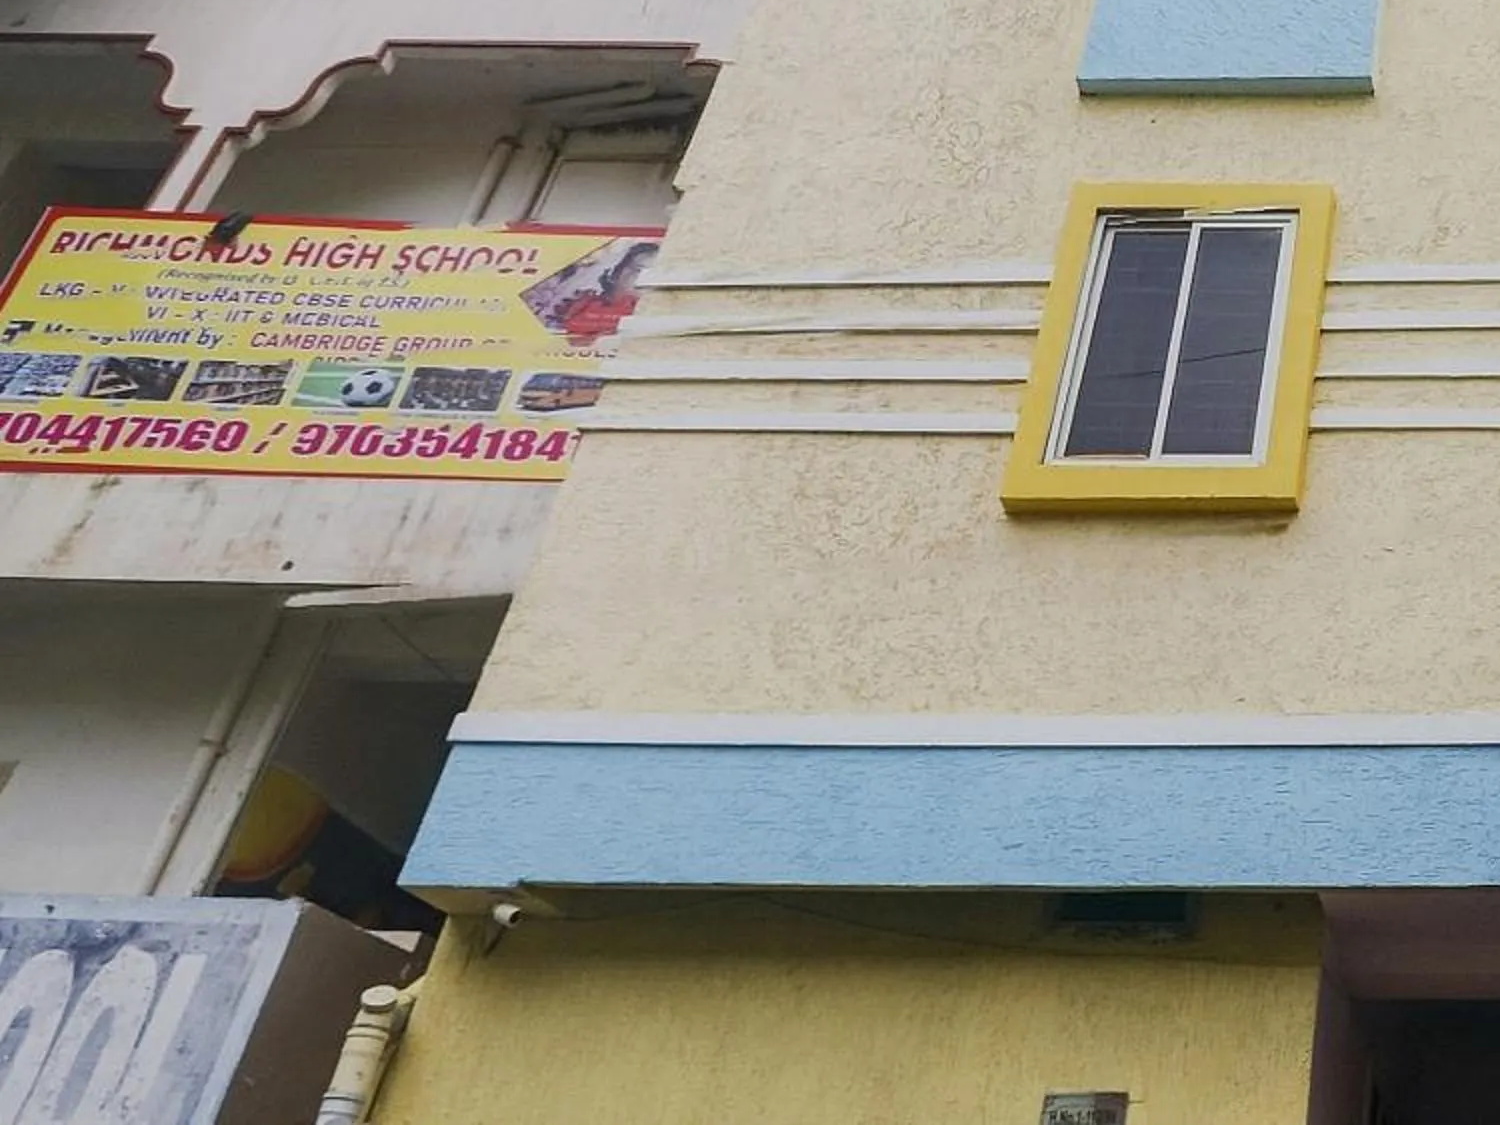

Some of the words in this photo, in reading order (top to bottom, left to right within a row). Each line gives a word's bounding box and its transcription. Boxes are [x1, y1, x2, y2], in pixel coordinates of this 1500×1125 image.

[282, 236, 386, 271] HIGH
[391, 243, 540, 274] SCHOOL
[40, 283, 84, 297] LKG
[293, 292, 353, 308] CBSE
[251, 331, 387, 354] CAMBRIDGE
